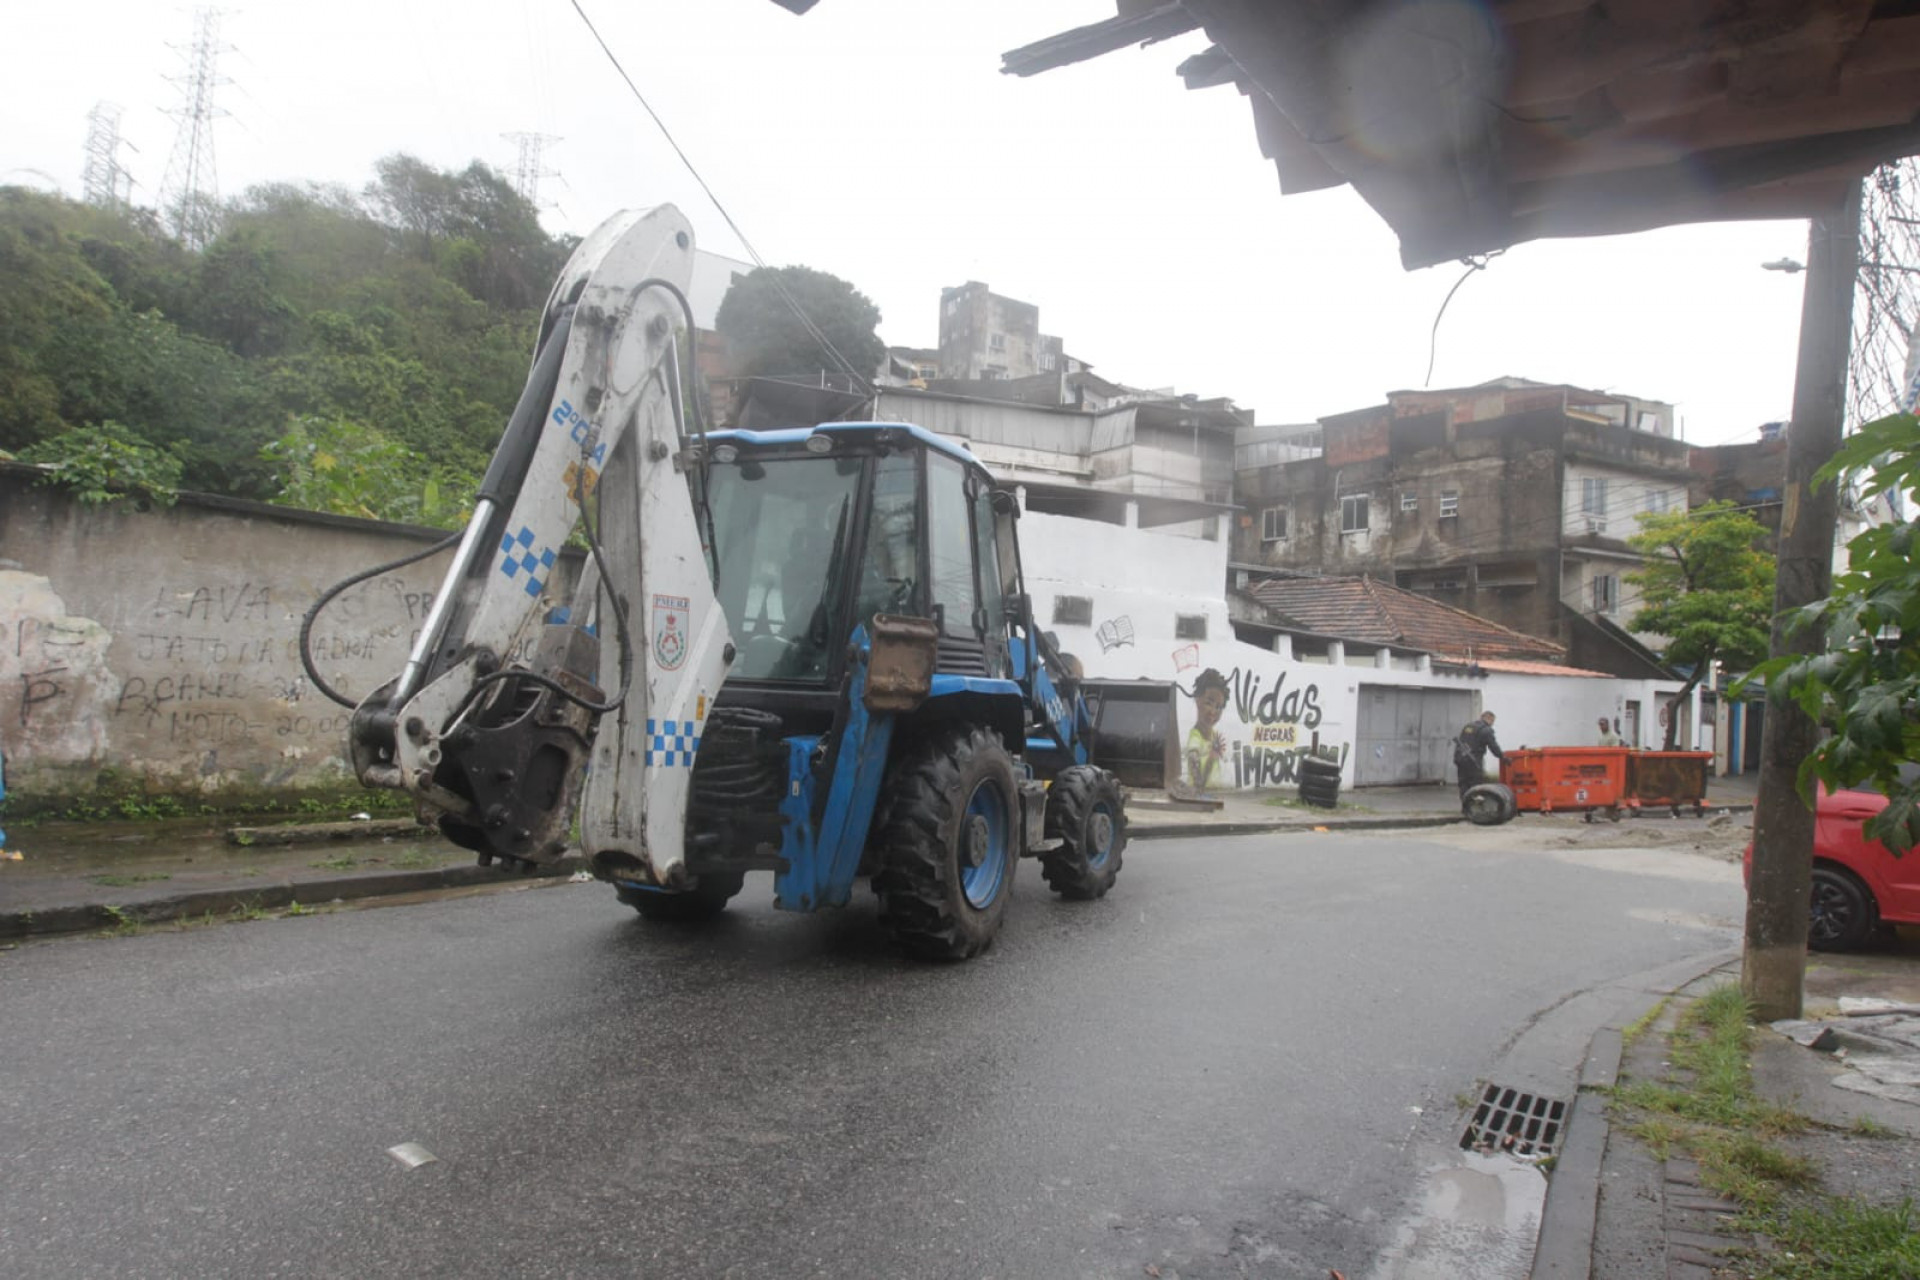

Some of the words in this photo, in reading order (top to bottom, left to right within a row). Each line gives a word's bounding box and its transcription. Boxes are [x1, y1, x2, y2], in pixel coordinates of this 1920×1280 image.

[154, 581, 272, 623] LAVA
[1227, 667, 1322, 730] Vidas
[1254, 726, 1295, 743] NEGRAS
